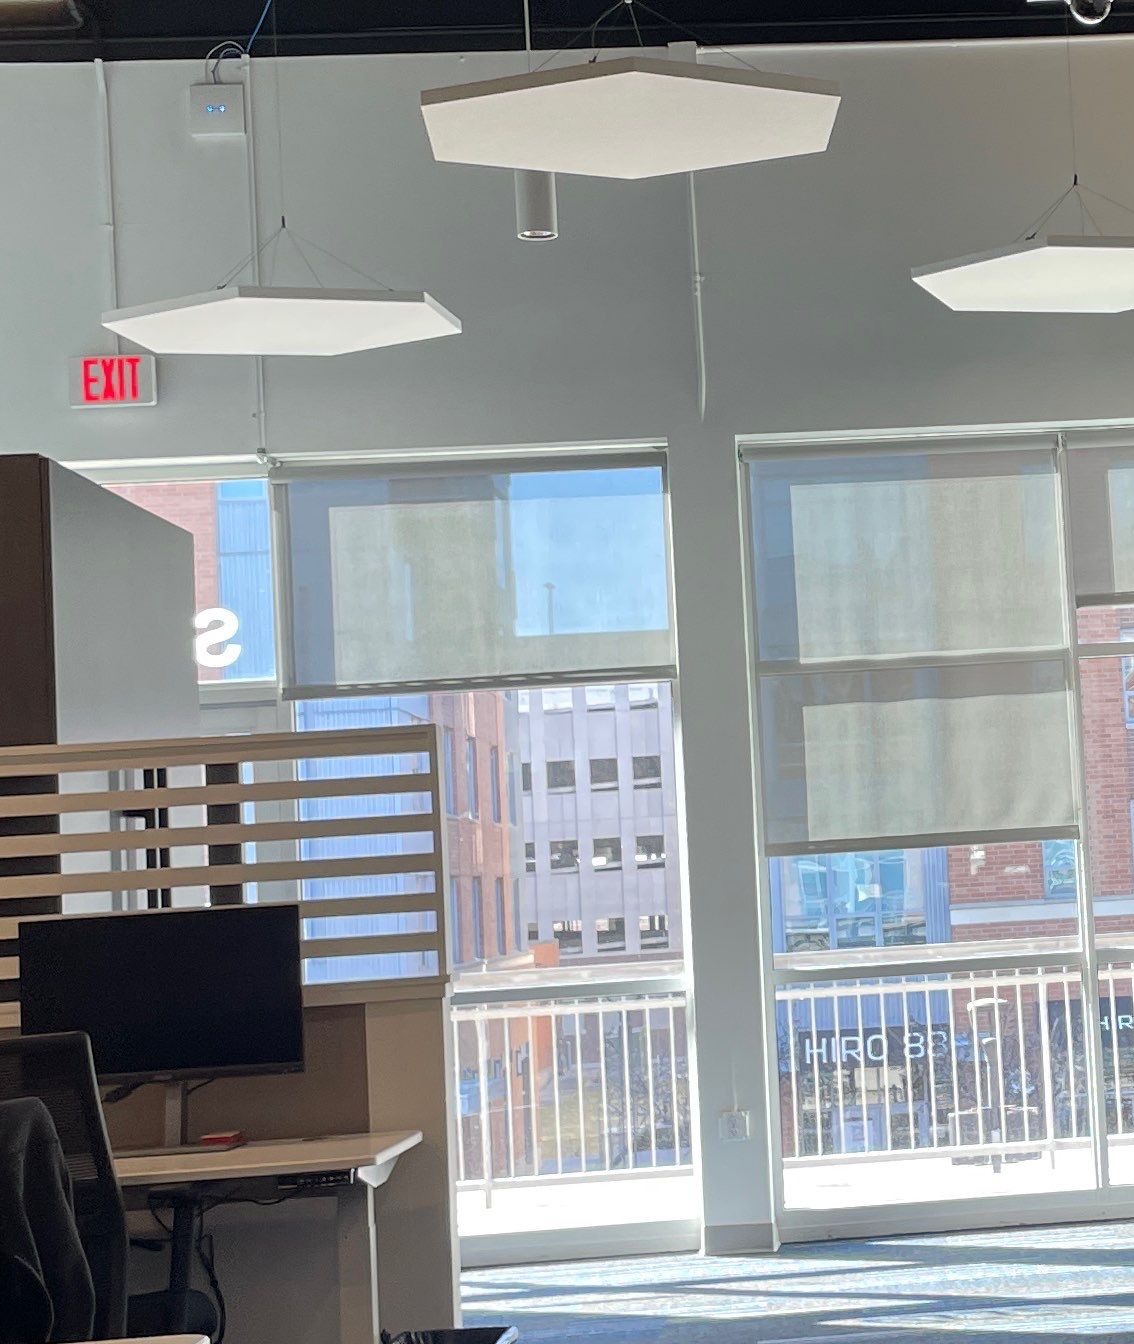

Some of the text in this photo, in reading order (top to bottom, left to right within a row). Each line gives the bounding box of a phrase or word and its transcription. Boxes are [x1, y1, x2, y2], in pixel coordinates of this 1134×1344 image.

[82, 356, 141, 402] EXIT
[804, 1030, 949, 1064] HIRO 88
